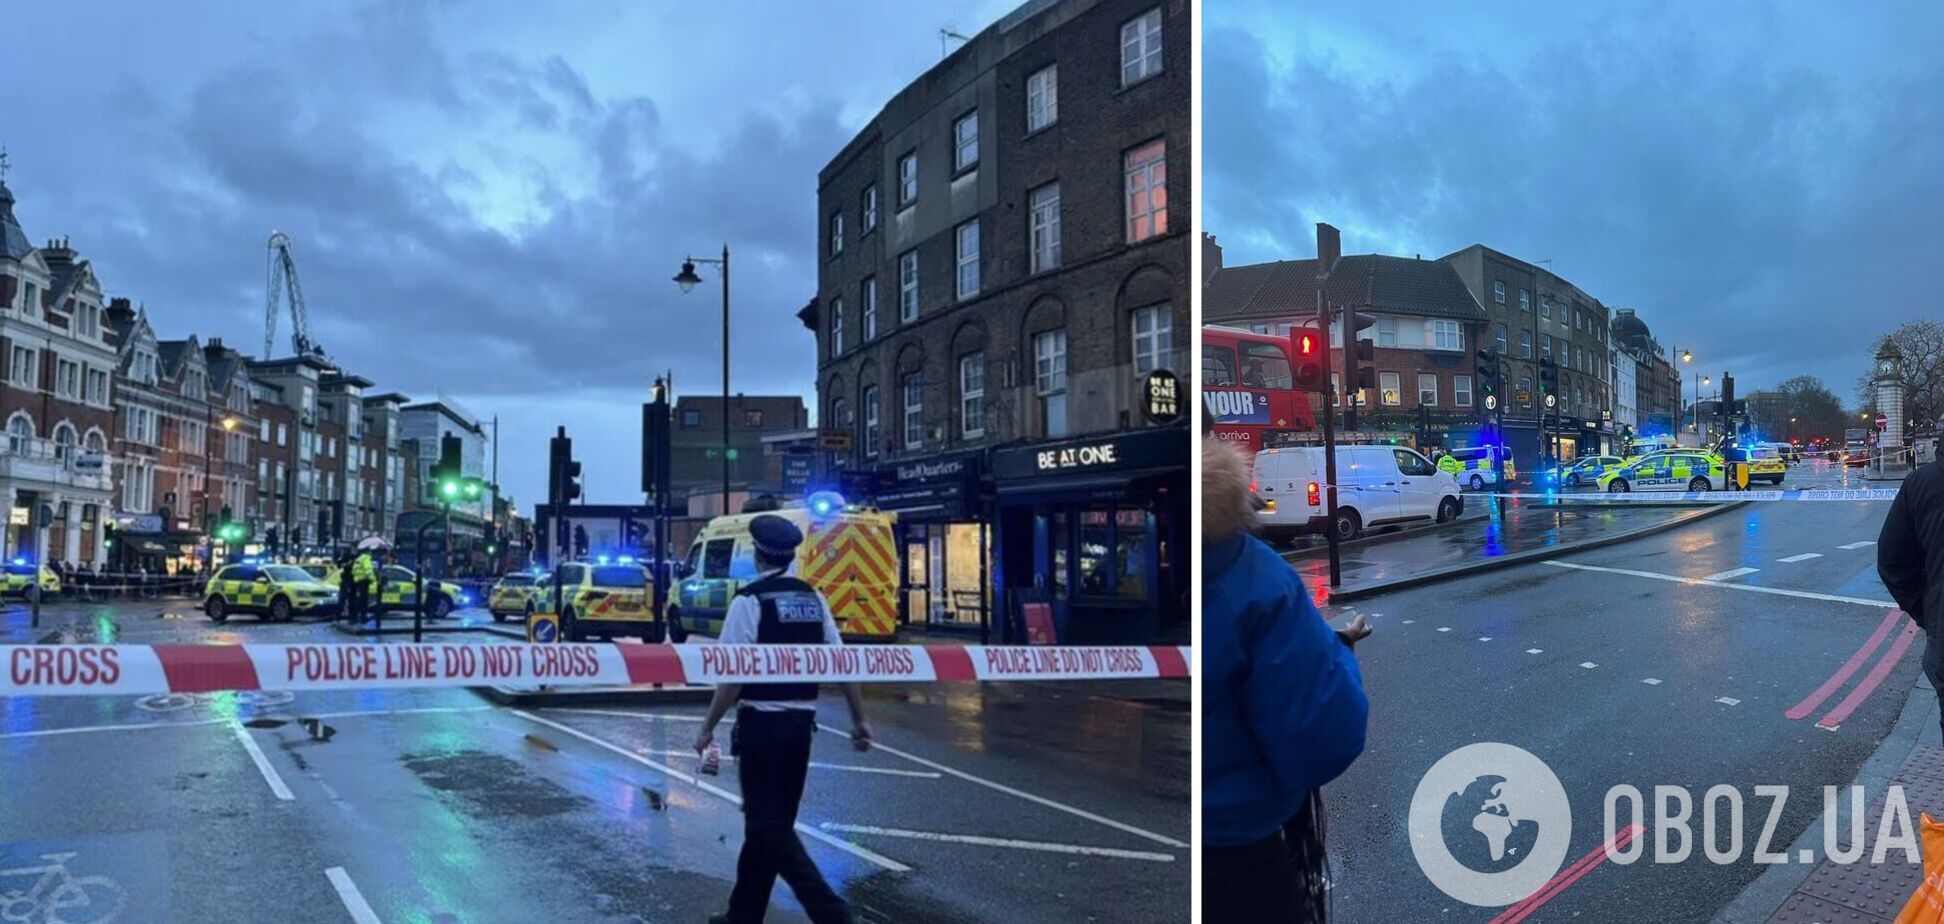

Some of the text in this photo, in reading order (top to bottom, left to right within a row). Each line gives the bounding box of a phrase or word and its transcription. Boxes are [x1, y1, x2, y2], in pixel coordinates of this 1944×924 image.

[1151, 386, 1176, 398] ONE
[1151, 402, 1176, 415] BAR
[1220, 431, 1250, 440] arriva
[1038, 444, 1116, 469] BE AT ONE
[1637, 478, 1687, 486] POLICE
[779, 604, 821, 620] POLICE
[11, 648, 120, 685] CROSS
[286, 645, 599, 681] POLICE LINE DO NOT CROSS
[701, 647, 914, 676] POLICE LINE DO NOT CROSS
[984, 648, 1143, 673] POLICE LINE DO NOT CROSS
